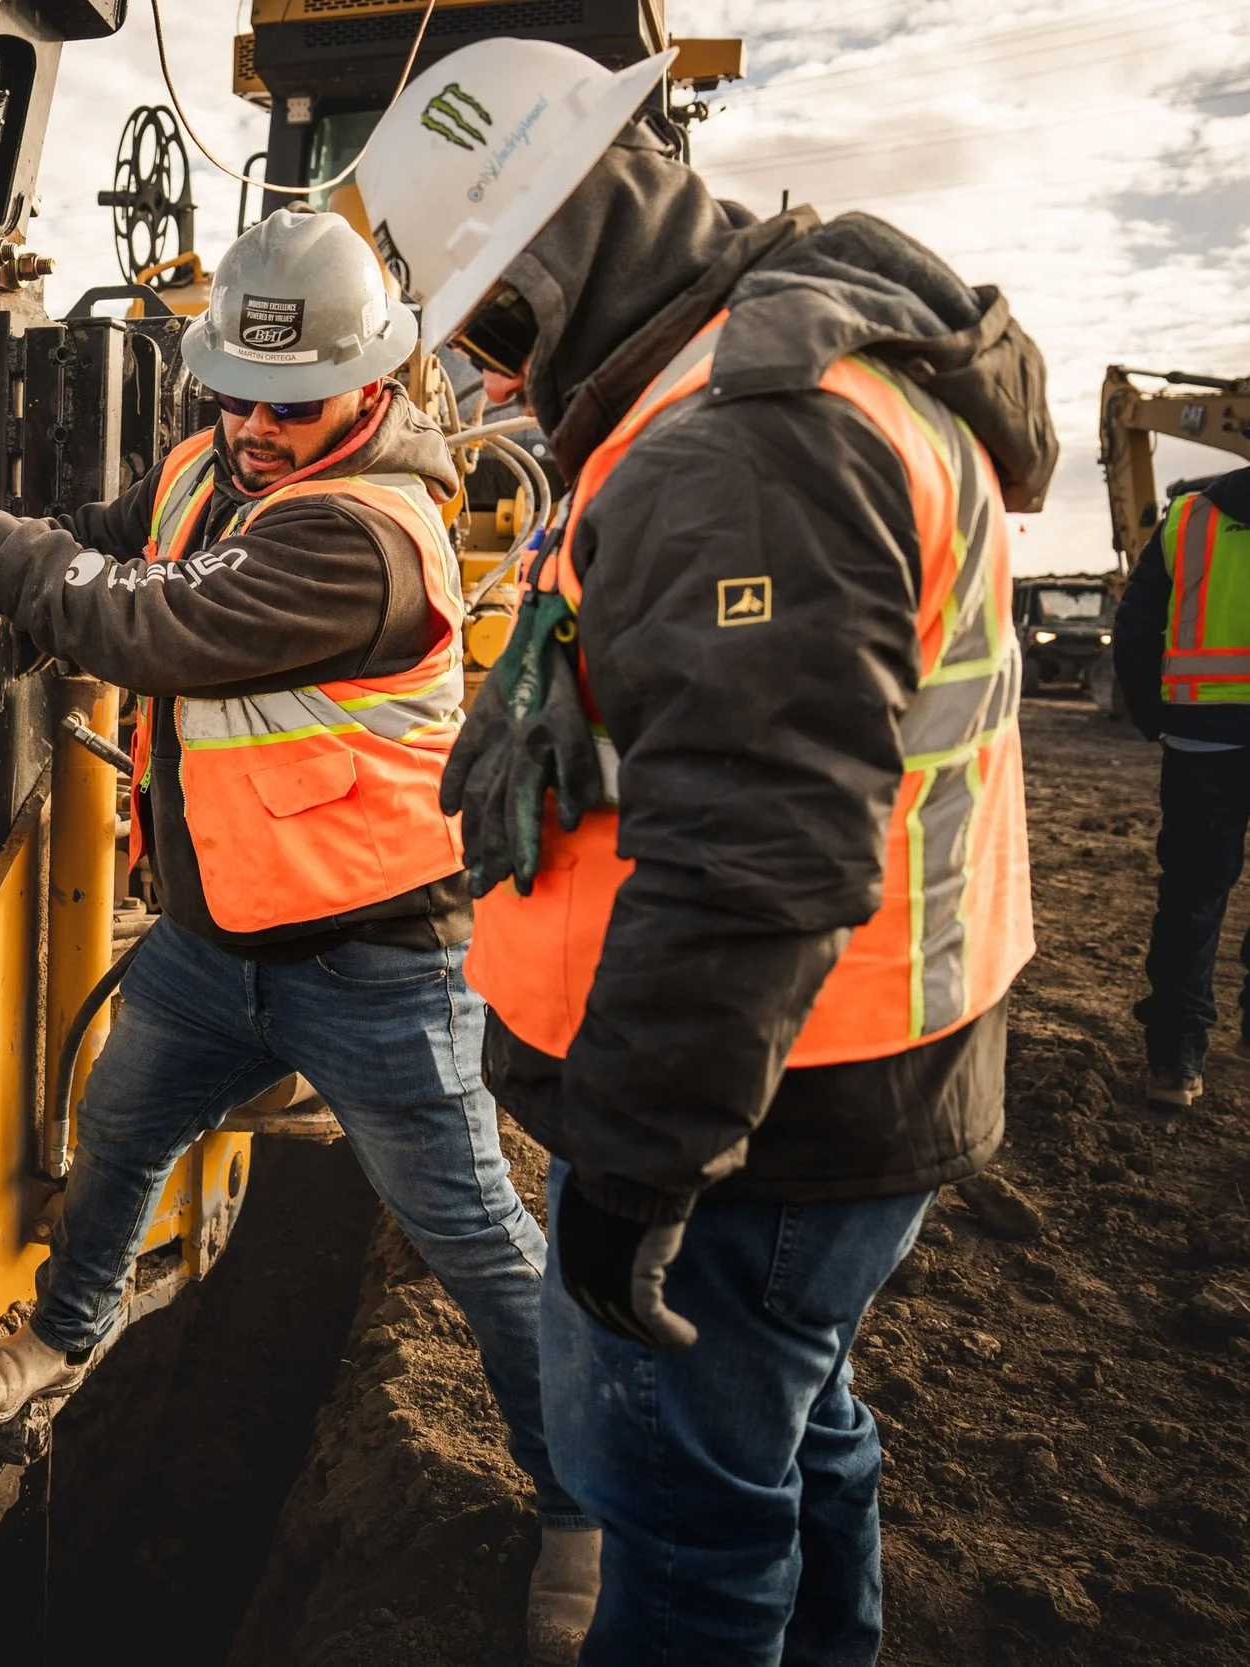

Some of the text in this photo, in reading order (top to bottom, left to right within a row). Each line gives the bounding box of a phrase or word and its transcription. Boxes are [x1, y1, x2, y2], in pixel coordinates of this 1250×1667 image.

[248, 300, 297, 311] INDUSTRY EXCELLENCE
[247, 311, 267, 321] POWERED
[268, 313, 274, 321] BY
[255, 329, 283, 342] BHI
[238, 349, 297, 361] MARTIN ORTEGA
